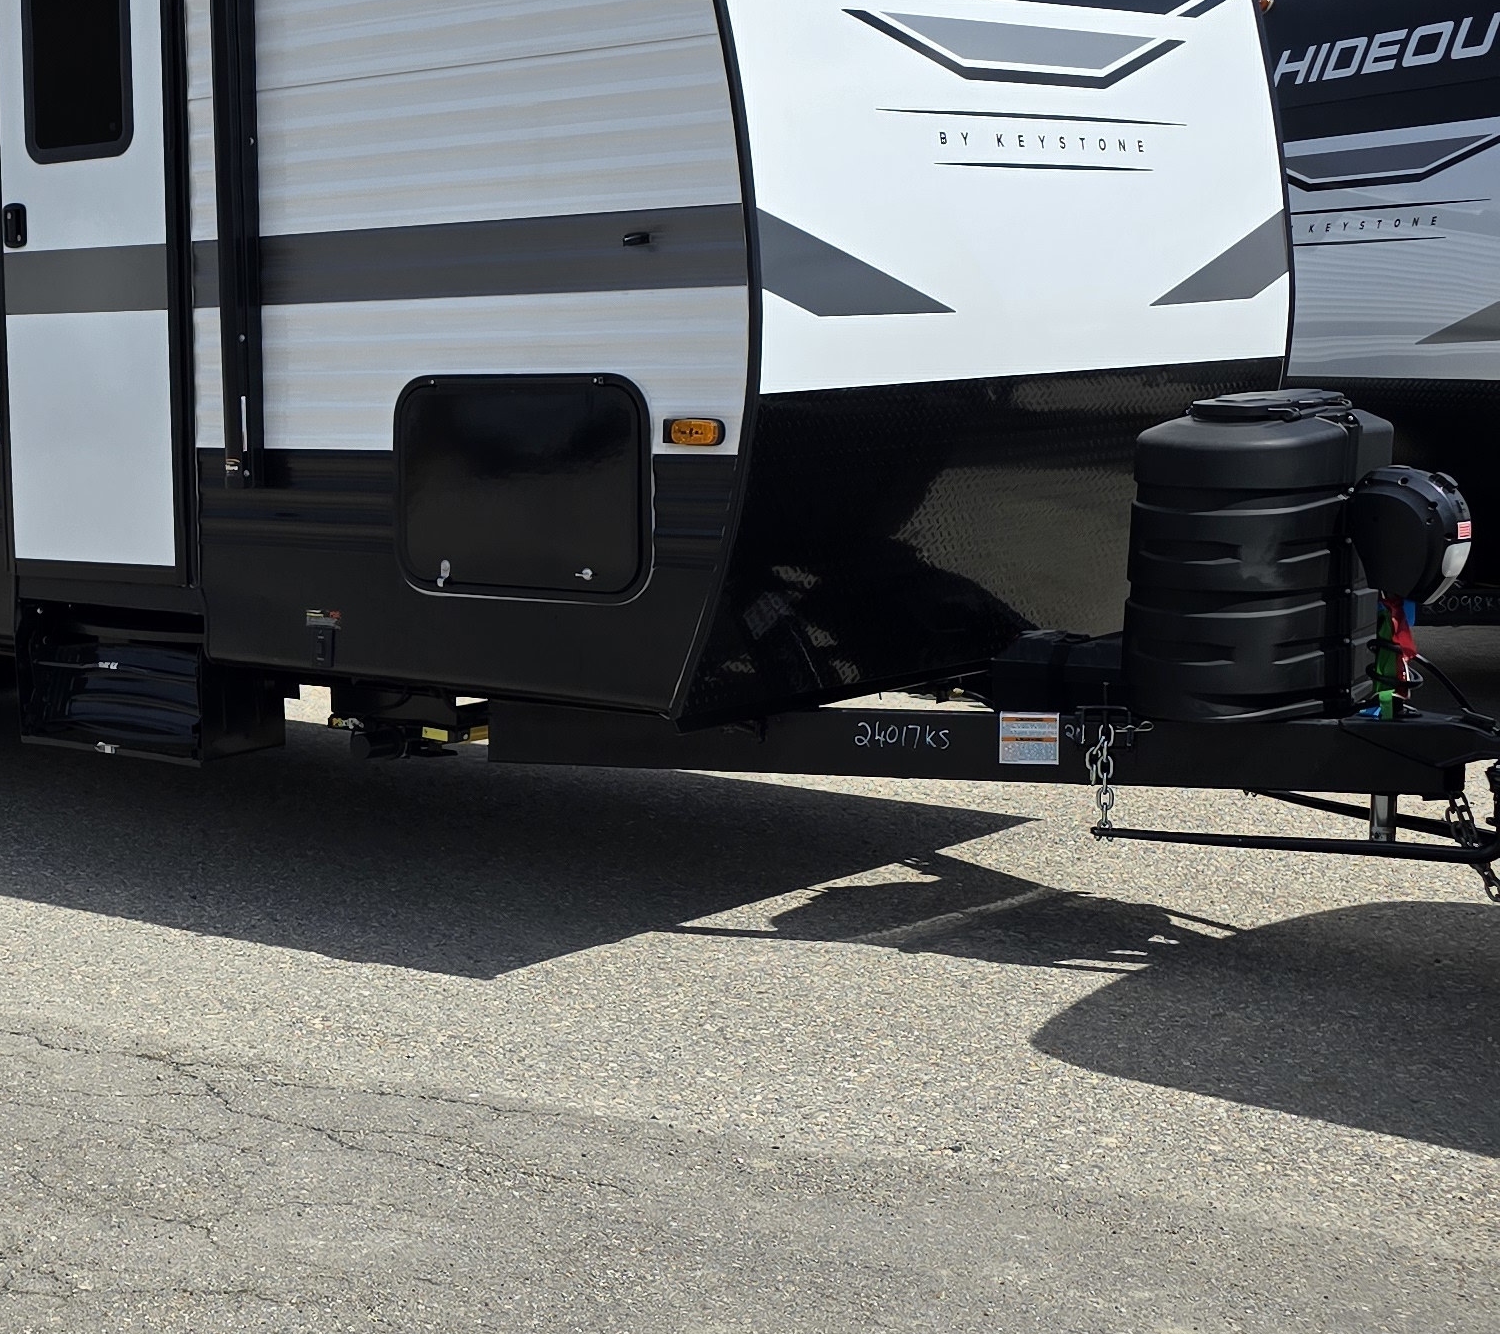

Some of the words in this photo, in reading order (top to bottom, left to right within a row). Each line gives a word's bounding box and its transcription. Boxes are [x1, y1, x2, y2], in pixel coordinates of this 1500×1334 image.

[939, 131, 969, 146] BY
[995, 133, 1145, 153] KEYSTONE
[1308, 216, 1438, 234] KEYSTONE
